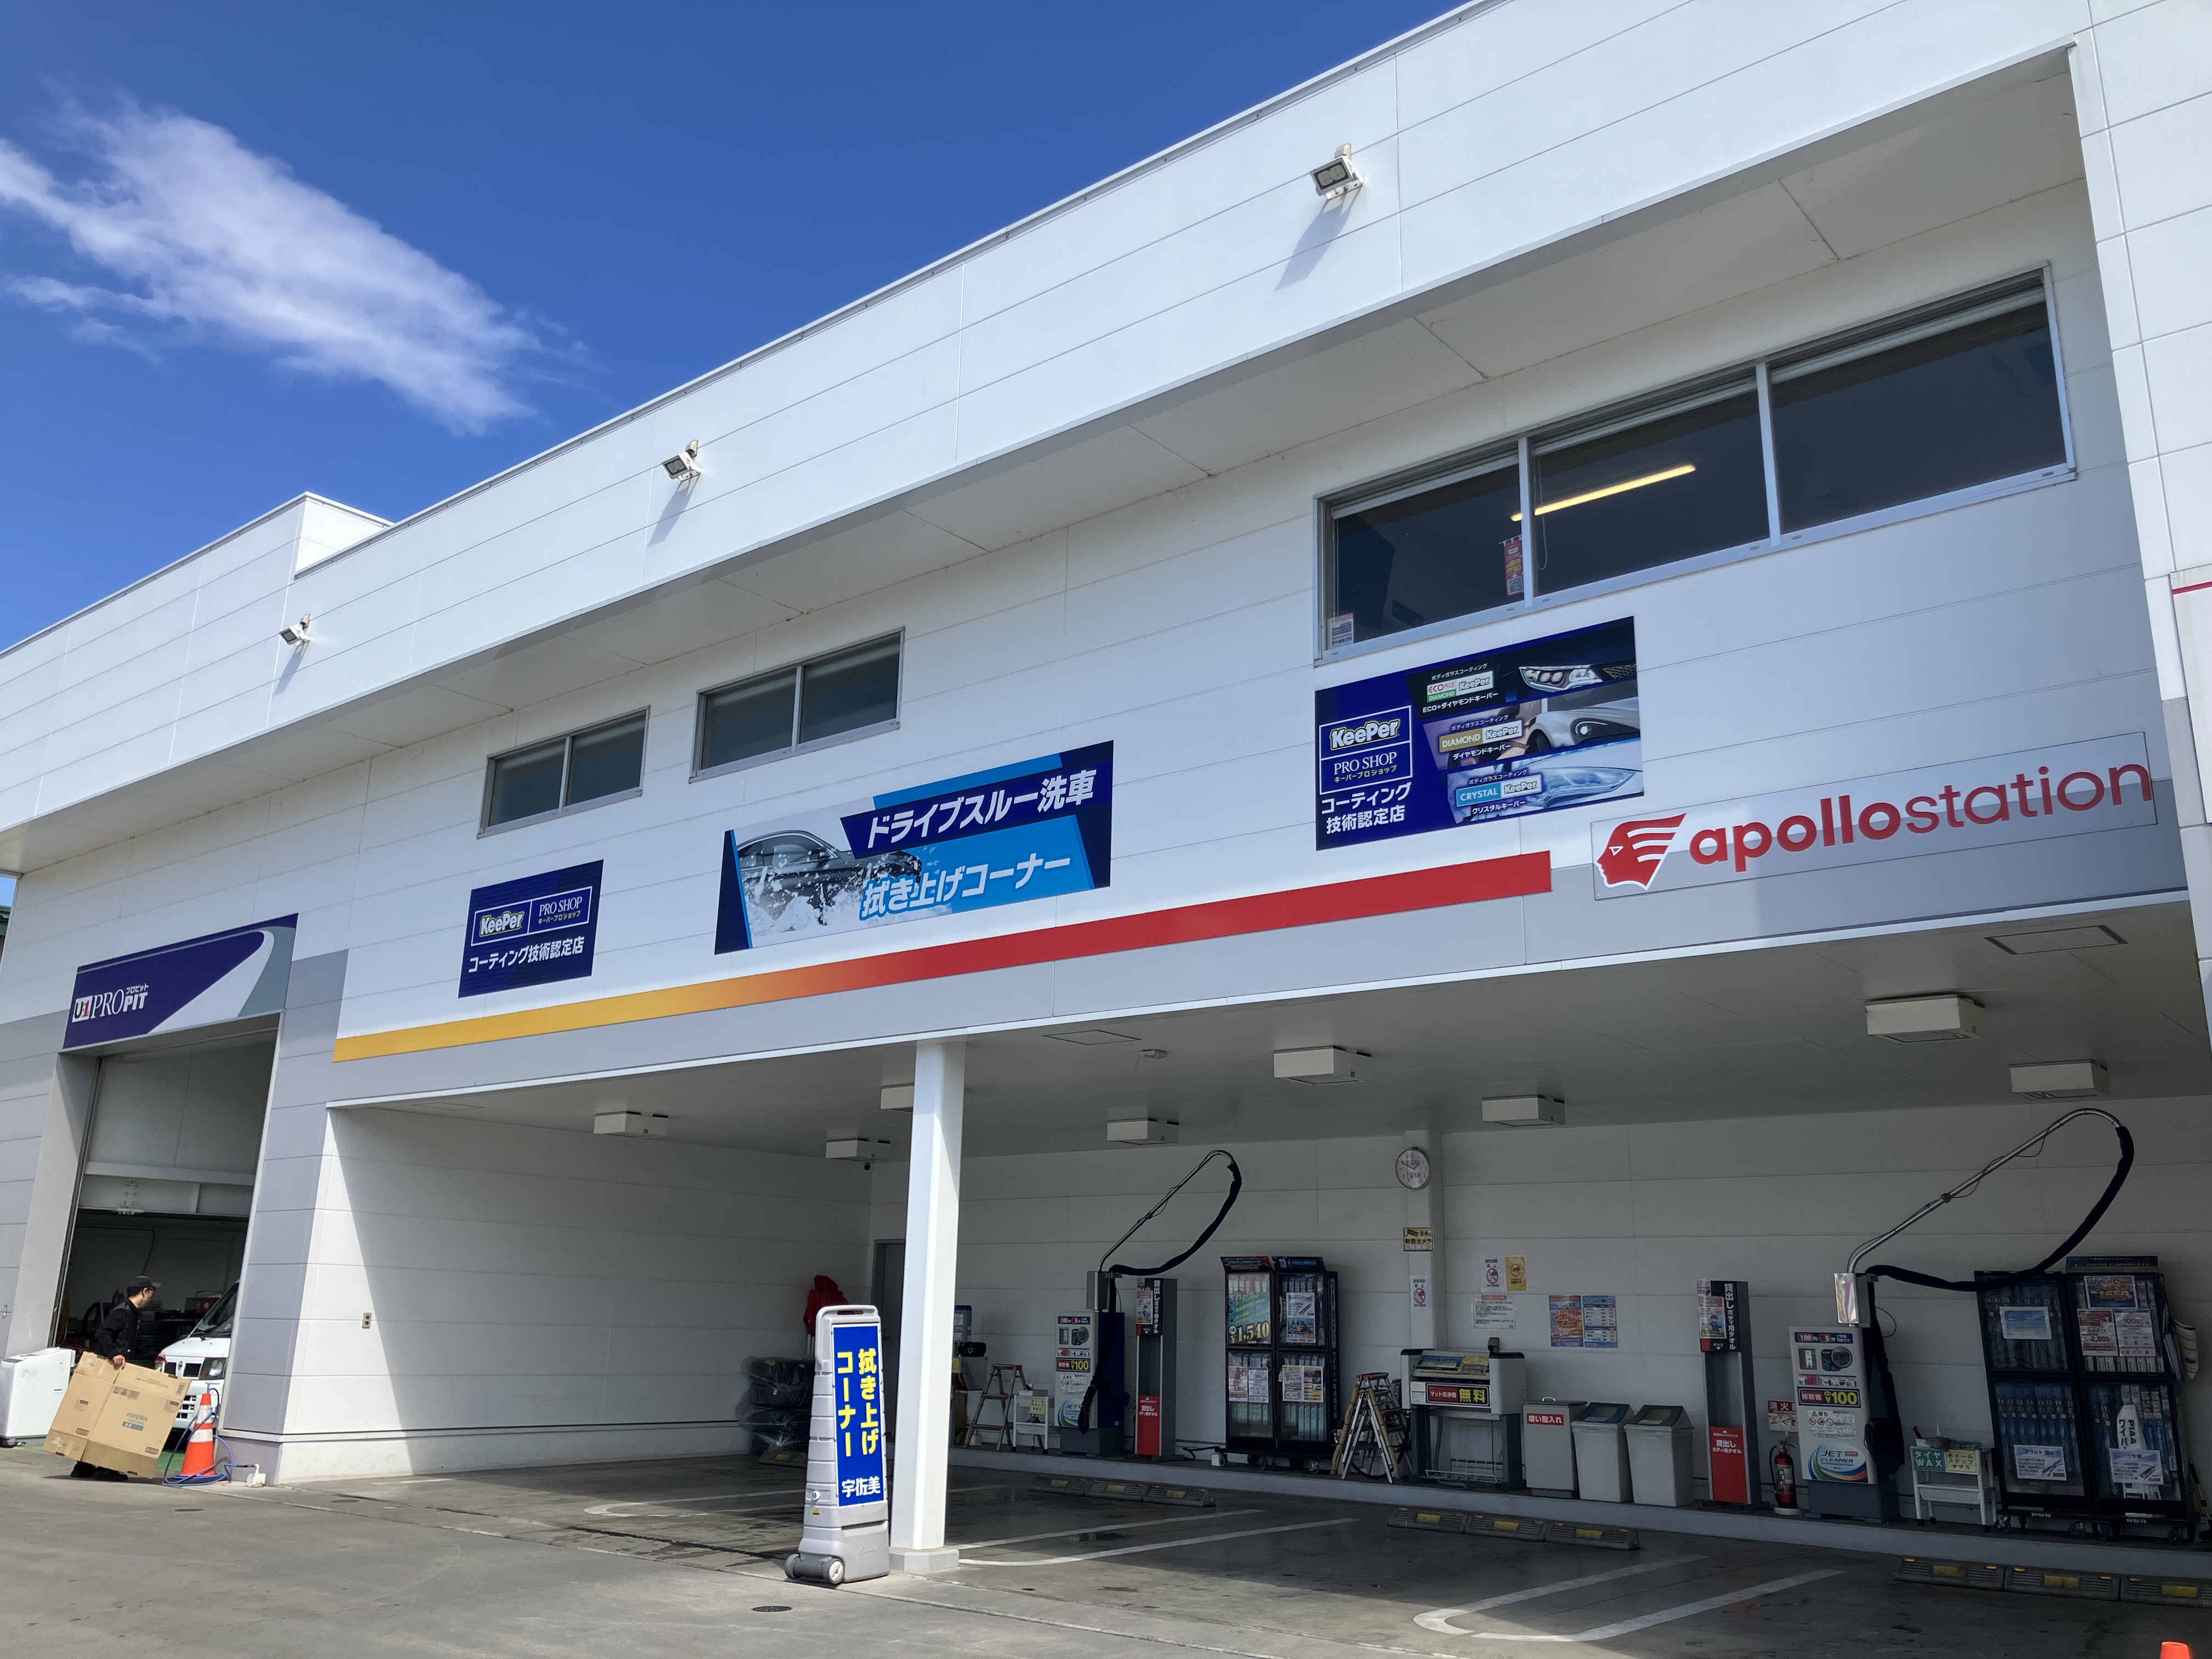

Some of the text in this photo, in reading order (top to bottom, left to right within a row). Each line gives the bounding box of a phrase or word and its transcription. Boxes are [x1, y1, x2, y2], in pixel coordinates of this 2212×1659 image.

[1428, 684, 1443, 693] ECO
[1458, 677, 1491, 691] KeePer
[1429, 691, 1455, 701] DIAMOND
[1330, 719, 1401, 751] KeePer
[1442, 726, 1519, 748] DIAMOND KeePer
[1334, 752, 1397, 775] PRO SHOP
[1334, 765, 1397, 783] キーパープロショップ
[1322, 782, 1412, 814] コーティング
[1460, 781, 1538, 802] CRYSTAL KeePer
[868, 769, 1097, 849] ドライブスルー洗車
[1472, 800, 1526, 815] クリスタルキーパー
[1689, 763, 2153, 873] apollostation
[1326, 805, 1405, 834] 技術認定店
[860, 853, 1071, 919] 拭き上げコーナー
[479, 896, 583, 936] KeePer PRO SHOP
[538, 910, 581, 925] キーパープロショップ
[468, 936, 585, 973] コーティング技術認定店
[837, 1351, 856, 1457] コーナー
[858, 1348, 878, 1455] 拭き上げ
[1459, 1388, 1486, 1403] 無料
[1915, 1450, 1941, 1459] タイヤ
[1915, 1459, 1942, 1468] WAX
[841, 1476, 881, 1498] 宇佐美
